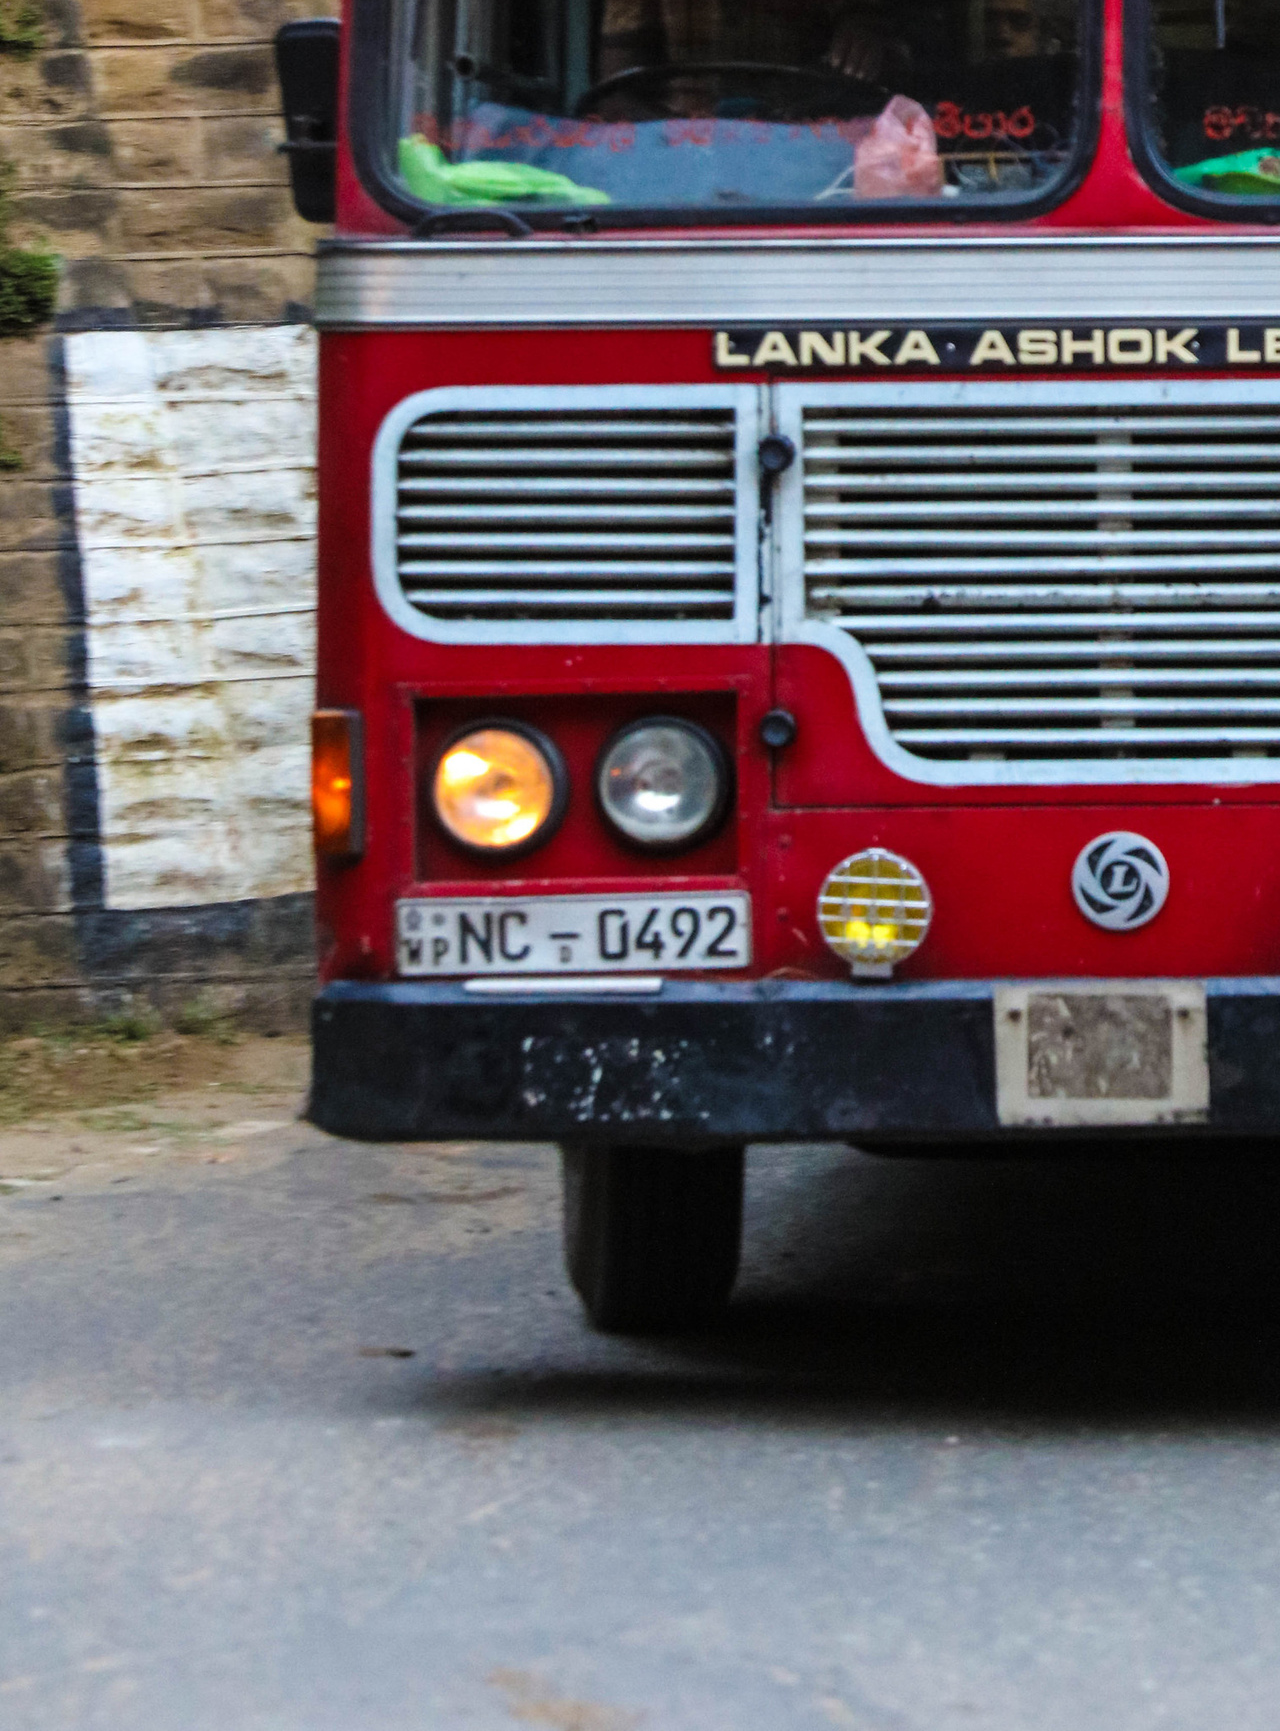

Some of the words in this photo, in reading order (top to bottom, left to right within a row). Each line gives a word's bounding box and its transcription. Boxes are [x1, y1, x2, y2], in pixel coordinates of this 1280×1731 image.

[715, 330, 941, 366] LANKA
[969, 328, 1200, 365] ASHOK
[458, 910, 532, 966] NC
[598, 905, 739, 961] 0492
